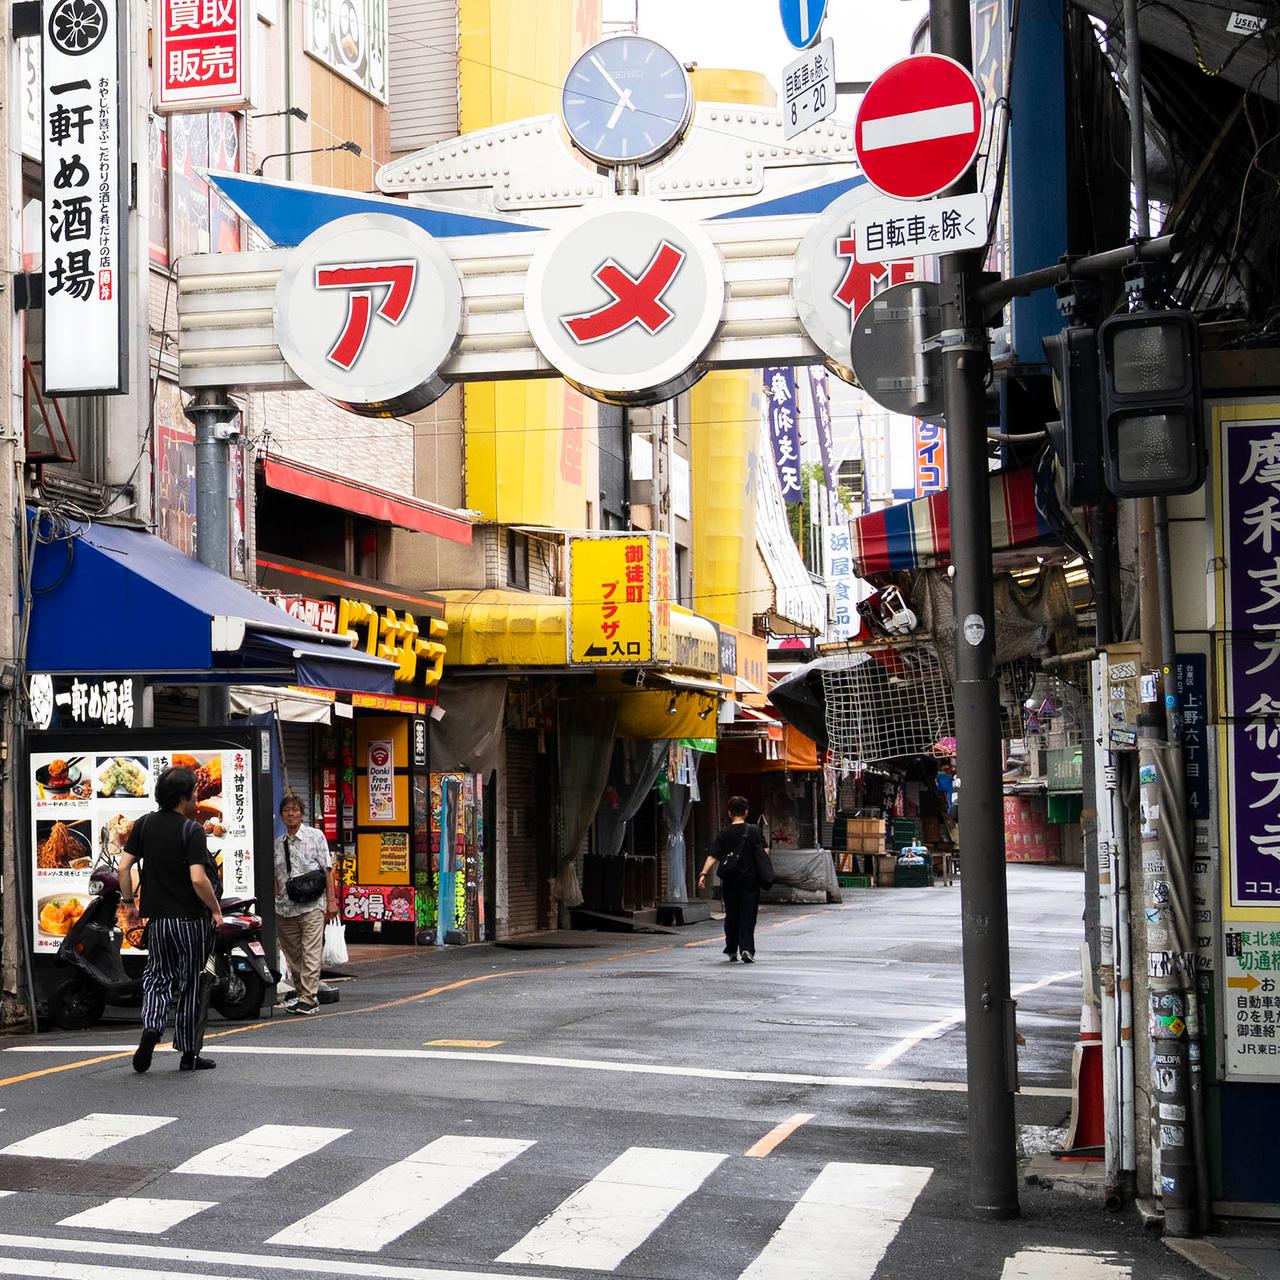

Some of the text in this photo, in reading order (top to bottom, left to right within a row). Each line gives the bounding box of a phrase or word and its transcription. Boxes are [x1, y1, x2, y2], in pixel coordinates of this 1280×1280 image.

[169, 45, 234, 84] 販売
[49, 77, 95, 302] 一軒め酒場
[866, 208, 977, 252] 自転車を除く
[625, 545, 643, 603] 御徒町
[601, 580, 620, 639] プラザ
[610, 642, 641, 656] 入口
[55, 677, 134, 729] 一軒め酒場
[370, 767, 390, 776] Donki
[370, 784, 390, 792] Wi-Fi
[372, 777, 388, 785] Free
